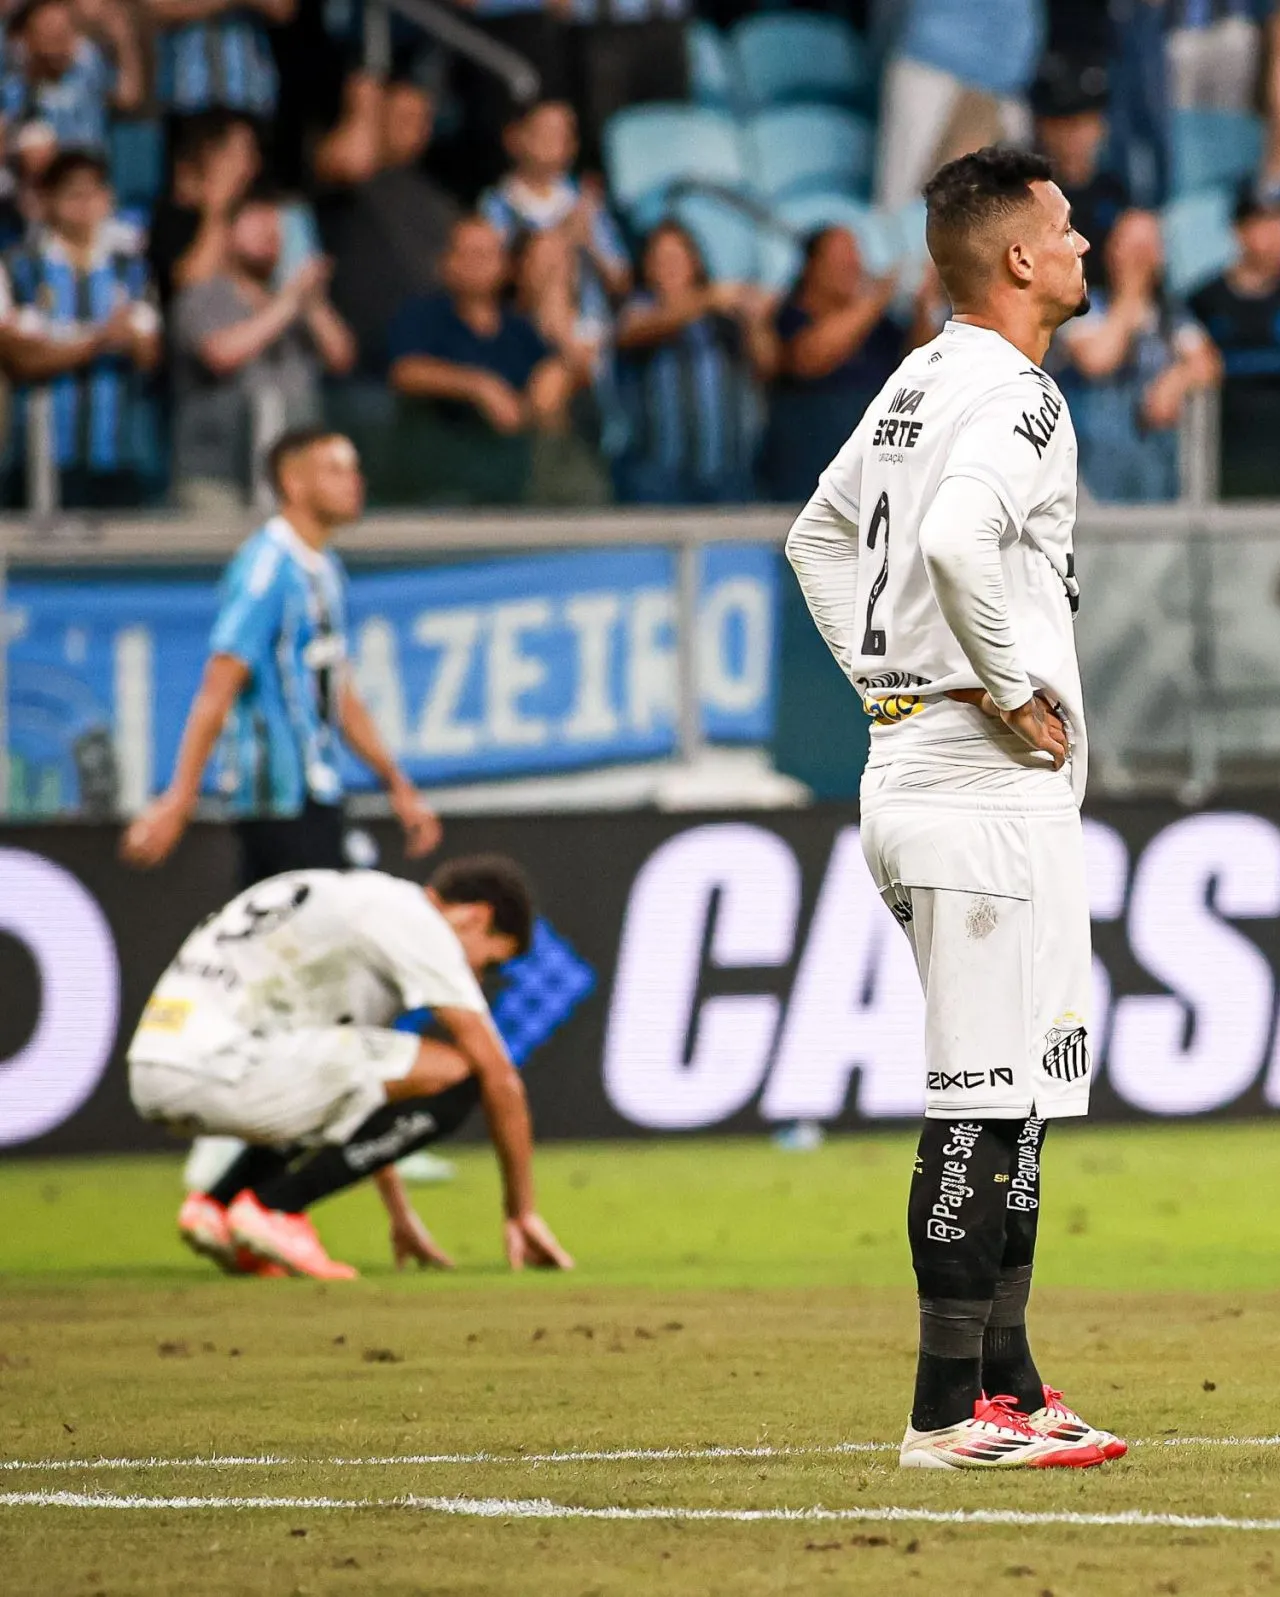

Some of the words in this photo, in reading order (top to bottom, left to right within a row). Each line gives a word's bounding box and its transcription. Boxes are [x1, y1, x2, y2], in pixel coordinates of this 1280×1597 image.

[860, 490, 890, 657] 2
[942, 1121, 983, 1159] Safe
[932, 1160, 975, 1220] Pague
[1011, 1145, 1040, 1192] Pague
